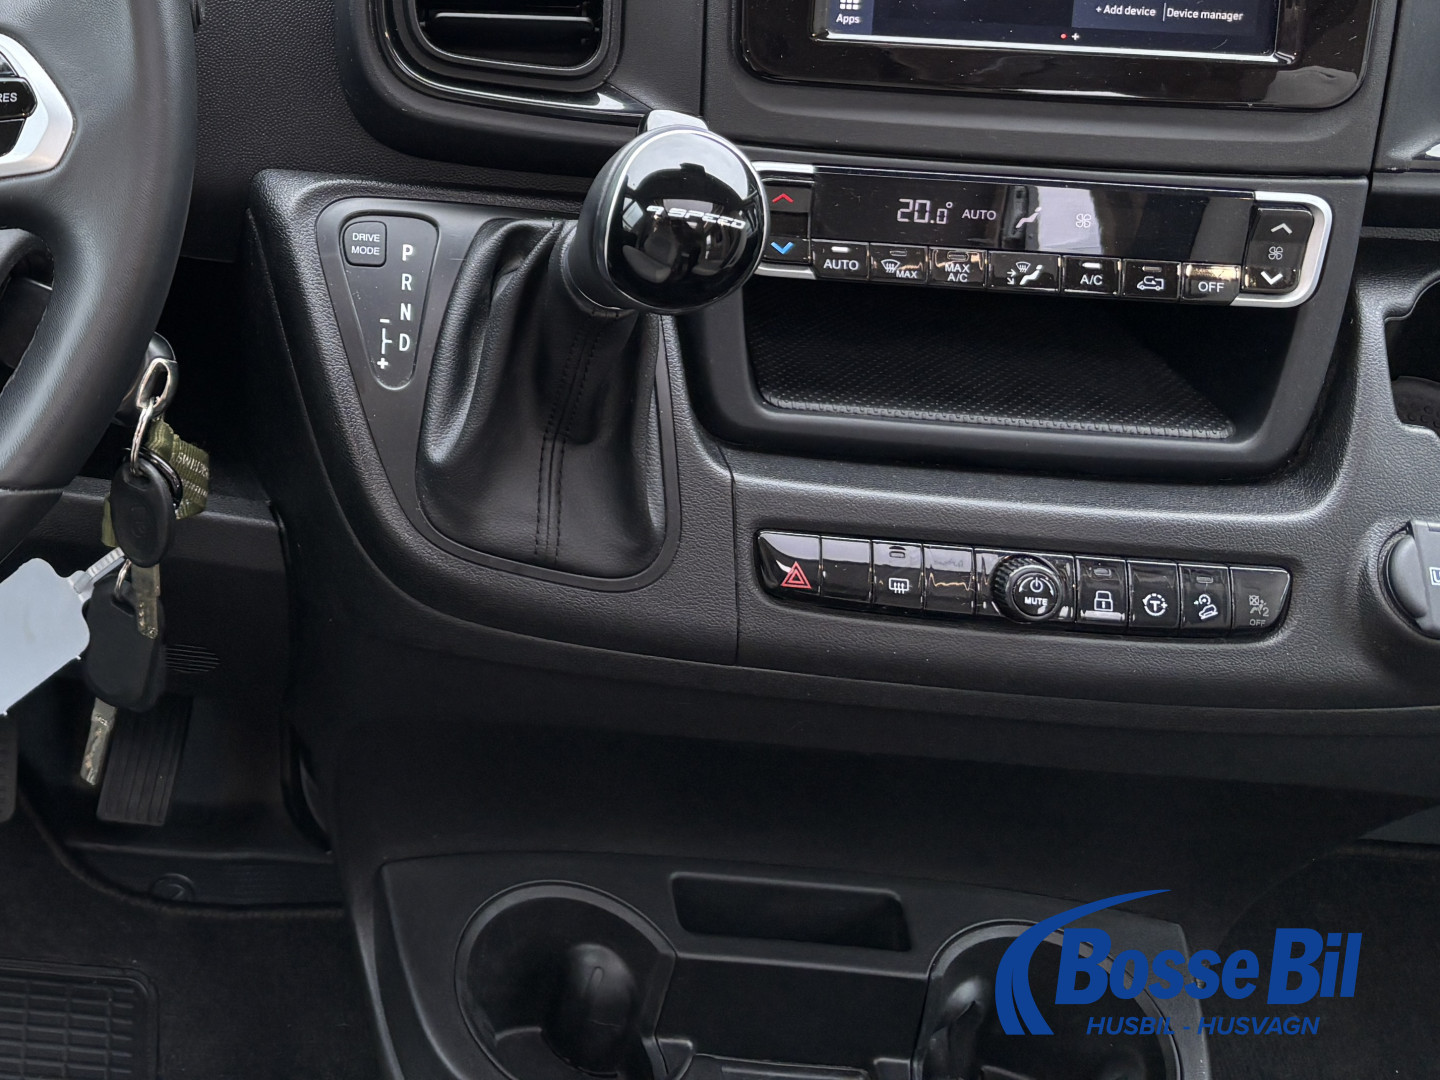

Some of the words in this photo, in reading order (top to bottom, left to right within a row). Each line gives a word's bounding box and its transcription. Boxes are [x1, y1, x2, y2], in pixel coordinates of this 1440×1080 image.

[1103, 4, 1123, 16] Add
[1124, 5, 1156, 17] device
[1166, 8, 1199, 19] Device
[1200, 10, 1244, 23] manager
[836, 14, 860, 25] Apps
[668, 207, 747, 230] SPEED
[961, 208, 997, 220] AUTO
[352, 232, 381, 243] DRIVE
[351, 245, 381, 256] MODE
[402, 244, 414, 262] P
[823, 258, 860, 271] AUTO
[944, 262, 971, 274] MAX
[896, 269, 918, 279] MAX
[947, 272, 969, 283] A/C
[1079, 273, 1103, 286] A/C
[401, 273, 413, 291] R
[1197, 281, 1225, 293] OFF
[400, 303, 412, 321] N
[399, 333, 411, 352] D
[1024, 596, 1049, 606] MUTE
[1249, 618, 1267, 628] OFF
